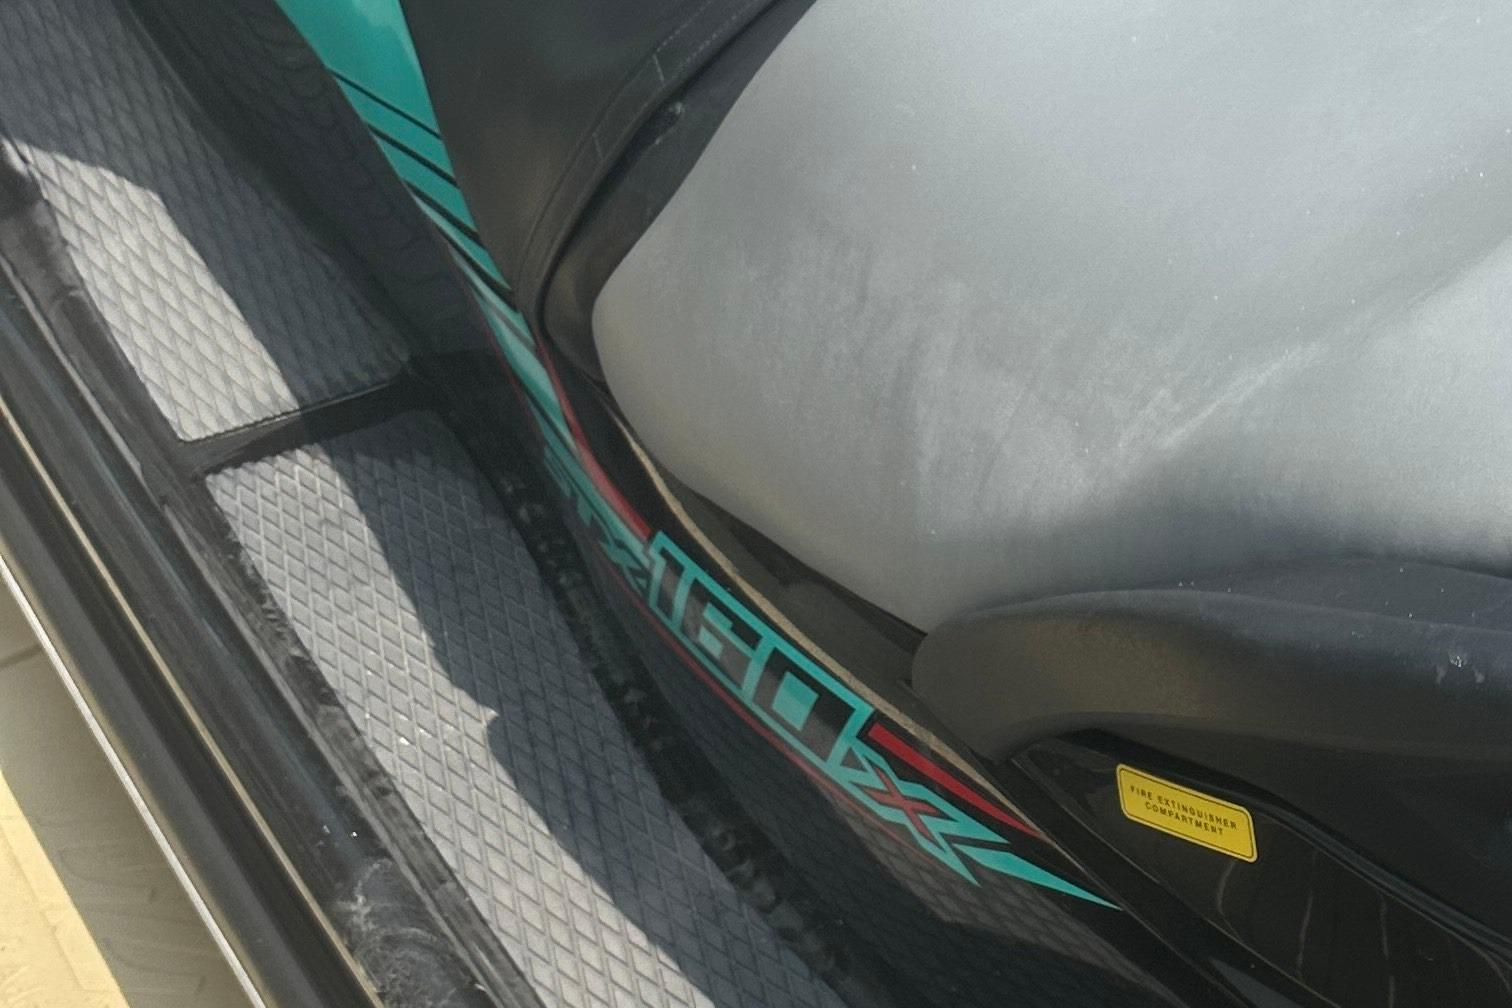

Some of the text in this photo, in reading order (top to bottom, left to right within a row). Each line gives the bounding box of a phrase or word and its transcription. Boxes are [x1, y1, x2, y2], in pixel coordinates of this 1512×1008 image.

[1130, 785, 1238, 830] FIRE EXTINGUISHER
[1145, 802, 1224, 835] COMPARTMENT
